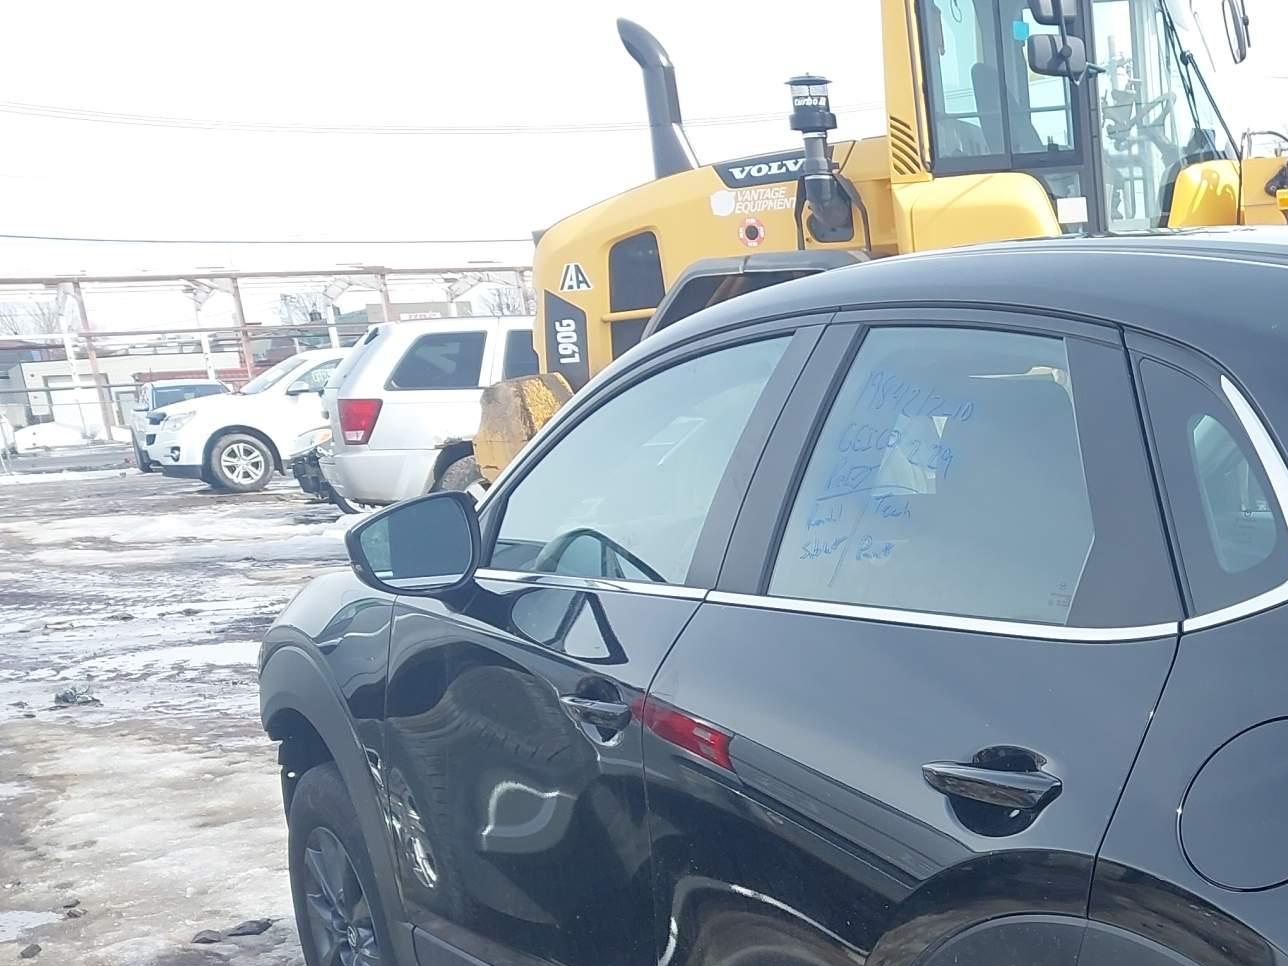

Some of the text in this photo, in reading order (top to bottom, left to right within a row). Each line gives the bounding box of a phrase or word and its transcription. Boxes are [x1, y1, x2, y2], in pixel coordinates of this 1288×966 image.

[728, 158, 808, 180] VOLV
[736, 187, 787, 201] VANTAGE
[735, 197, 797, 213] EQUIPMENT
[555, 319, 580, 364] L90G
